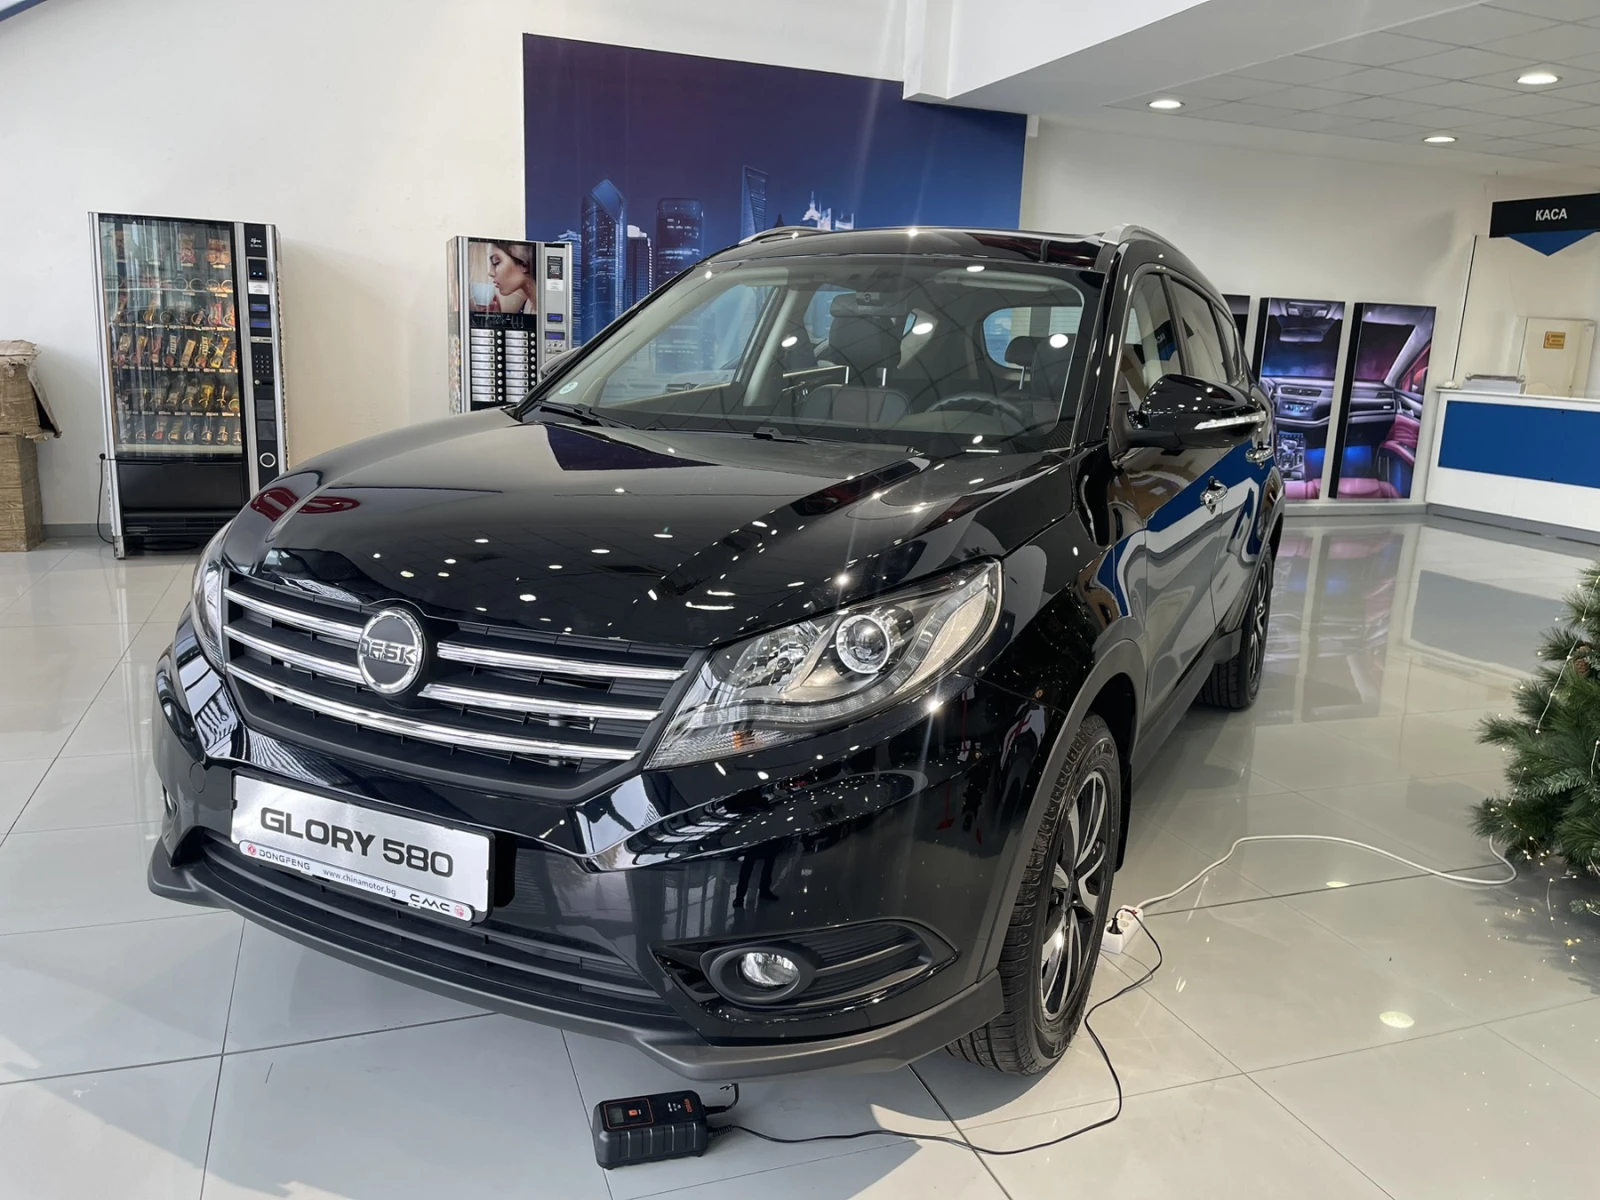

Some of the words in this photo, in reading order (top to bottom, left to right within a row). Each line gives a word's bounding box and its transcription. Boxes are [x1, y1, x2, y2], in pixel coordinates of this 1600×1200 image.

[1535, 208, 1568, 221] КАСА
[360, 638, 417, 665] DFSK
[260, 807, 376, 857] GLORY
[383, 838, 453, 878] 580
[259, 849, 311, 871] DONGFENG
[322, 868, 397, 897] www.chinamotor.bg
